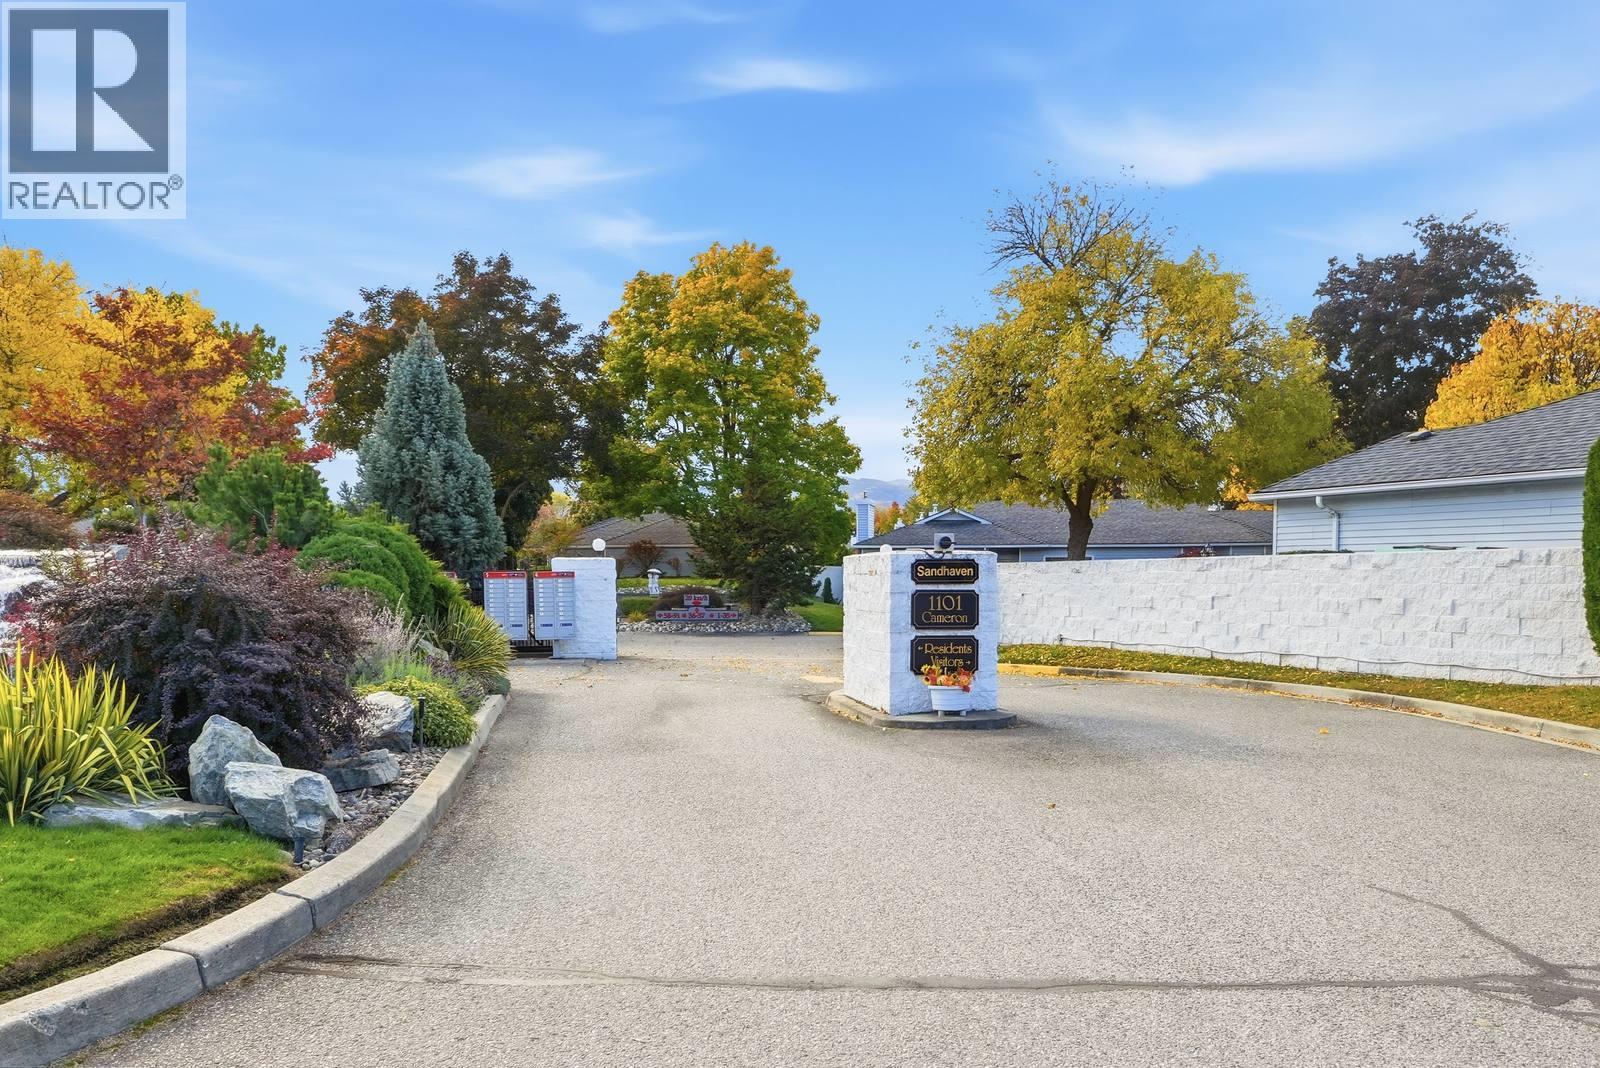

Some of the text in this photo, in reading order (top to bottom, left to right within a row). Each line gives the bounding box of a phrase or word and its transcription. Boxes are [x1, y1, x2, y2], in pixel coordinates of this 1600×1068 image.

[917, 566, 973, 576] Sandhaven
[929, 595, 962, 610] 1101
[921, 612, 968, 623] Cameron
[925, 643, 972, 653] Residents
[930, 655, 964, 667] Visitors
